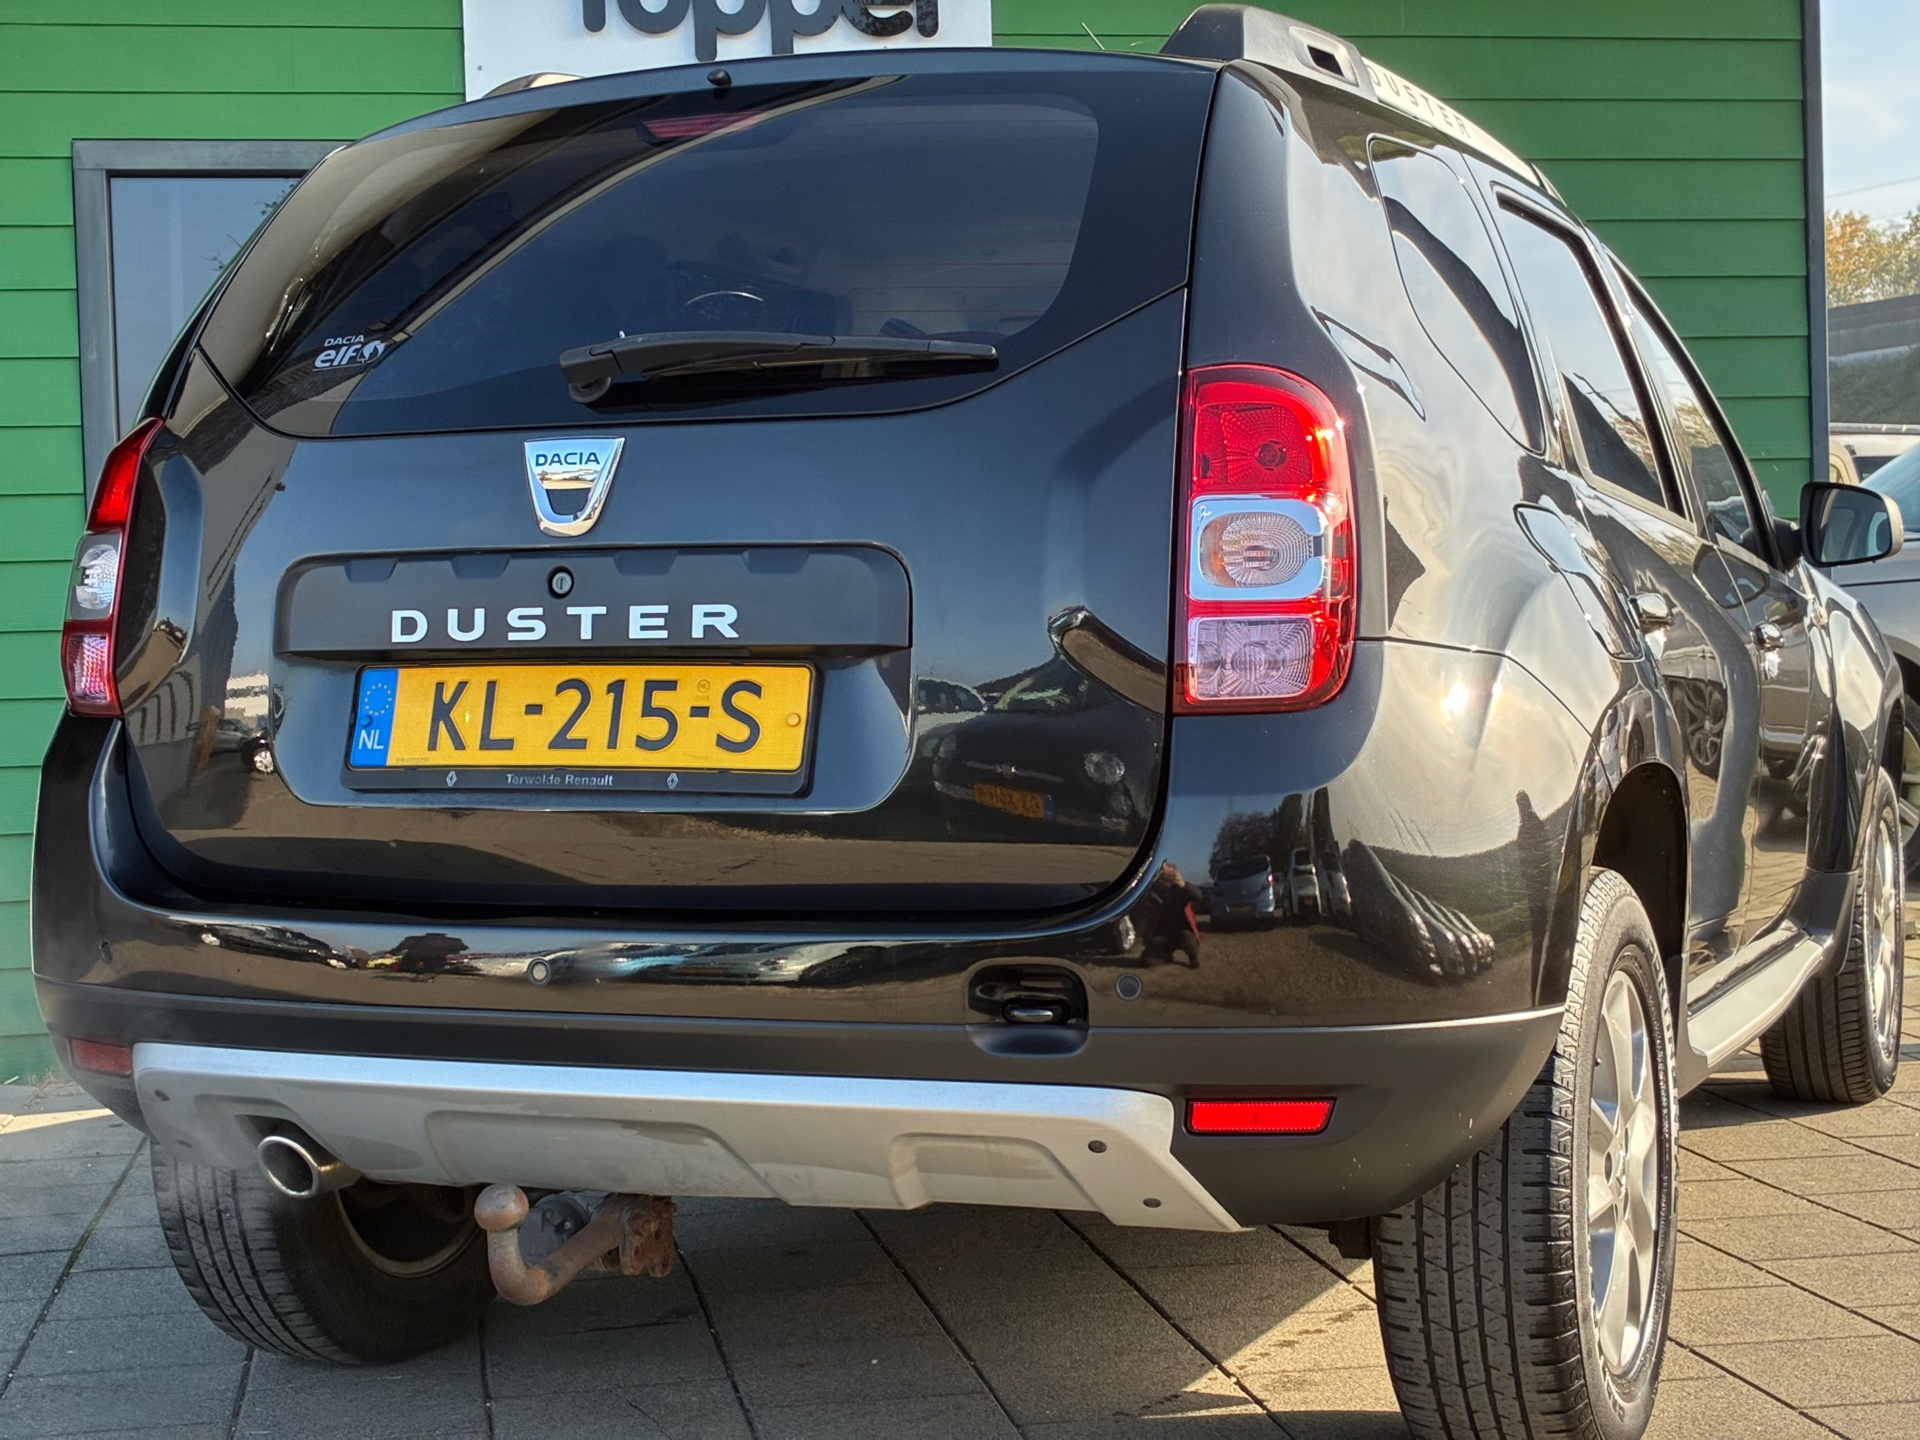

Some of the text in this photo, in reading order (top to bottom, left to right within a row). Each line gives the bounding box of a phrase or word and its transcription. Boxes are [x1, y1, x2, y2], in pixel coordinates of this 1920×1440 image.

[1366, 63, 1471, 139] DUSTER
[324, 334, 365, 347] DACIA
[535, 451, 600, 467] DACIA
[391, 603, 740, 643] DUSTER
[427, 678, 764, 753] KL-215-S
[358, 729, 385, 750] NL
[506, 774, 614, 786] Terwolde Renault
